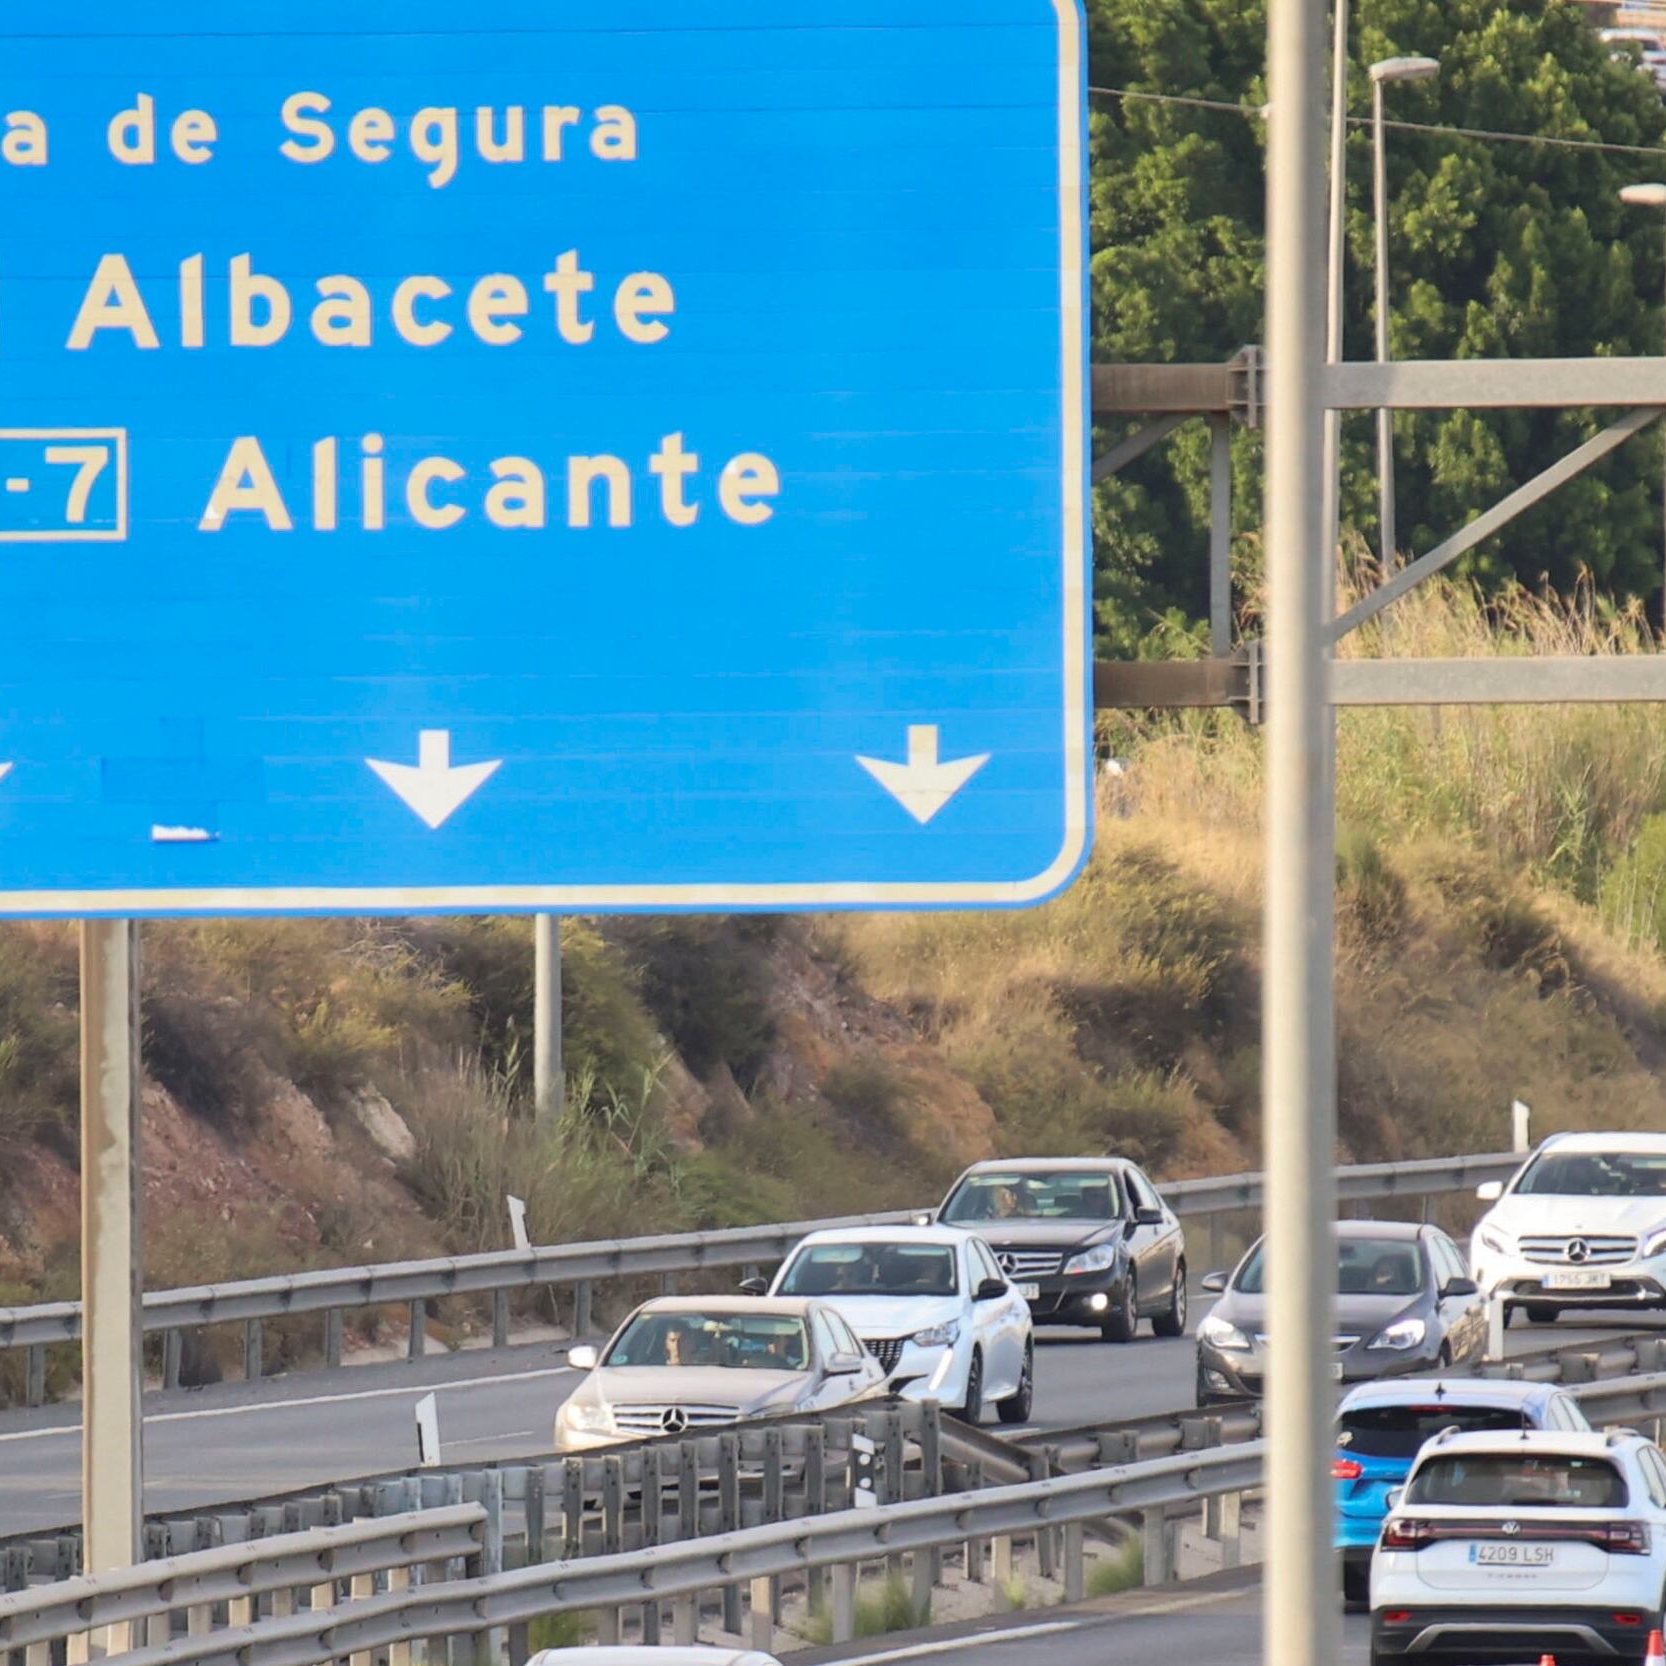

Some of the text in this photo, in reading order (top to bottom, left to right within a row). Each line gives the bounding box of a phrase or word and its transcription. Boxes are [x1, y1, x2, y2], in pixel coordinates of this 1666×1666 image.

[108, 93, 218, 166] de
[280, 91, 638, 190] Segura
[67, 250, 677, 350] Albacete
[199, 432, 781, 532] Alicante
[1478, 1546, 1554, 1562] 4209 LSH
